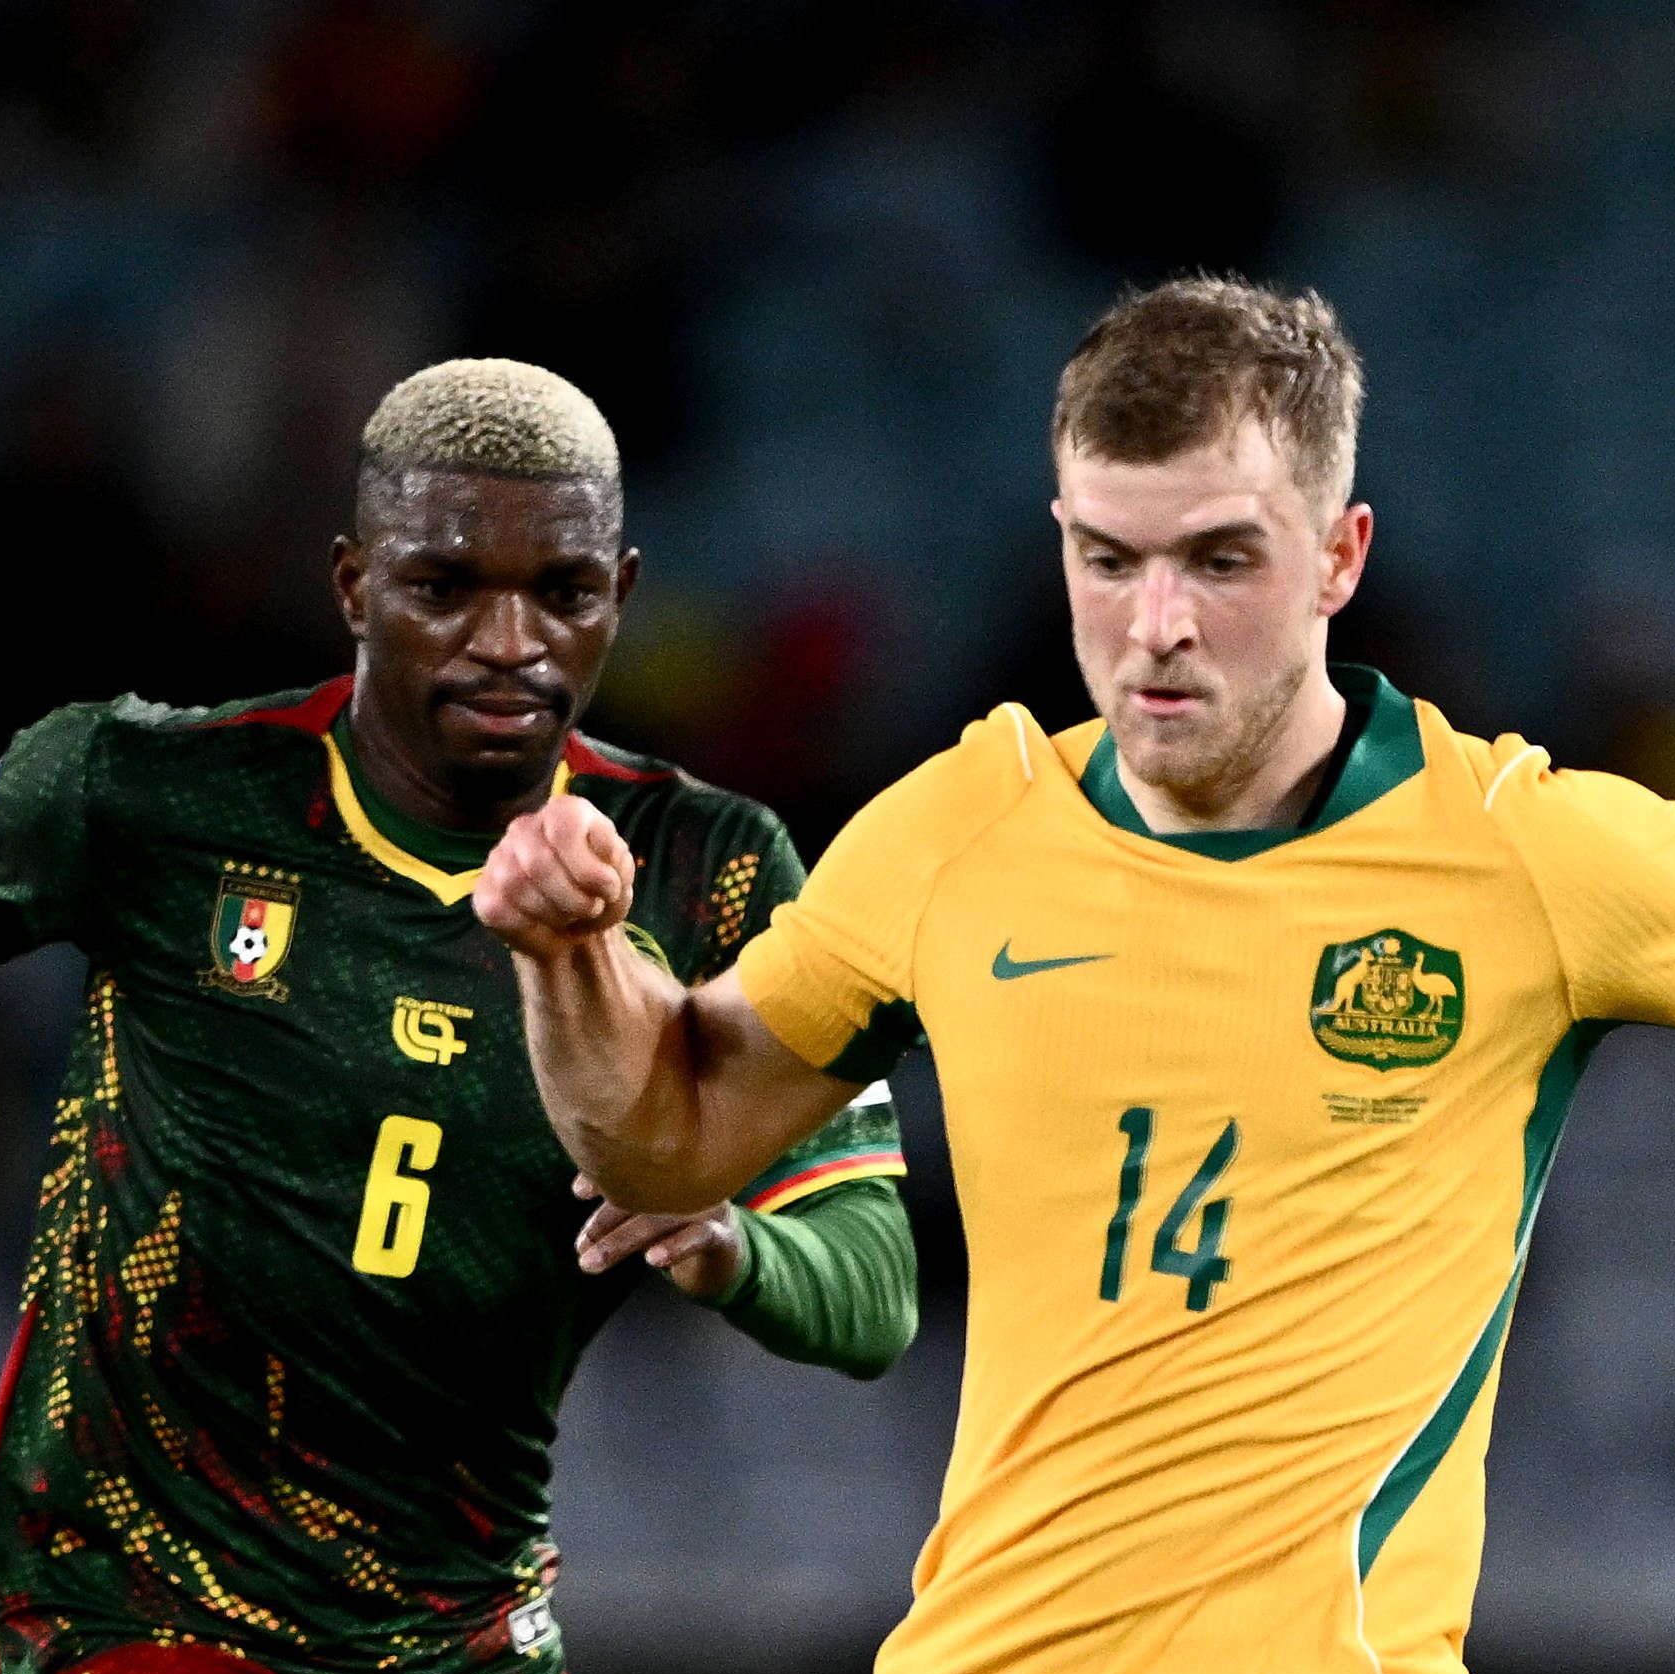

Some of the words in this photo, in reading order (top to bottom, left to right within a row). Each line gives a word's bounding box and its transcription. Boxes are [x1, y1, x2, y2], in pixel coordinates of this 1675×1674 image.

[1333, 1017, 1438, 1036] AUSTRALIA
[352, 1114, 443, 1278] 6
[1099, 1107, 1242, 1311] 14
